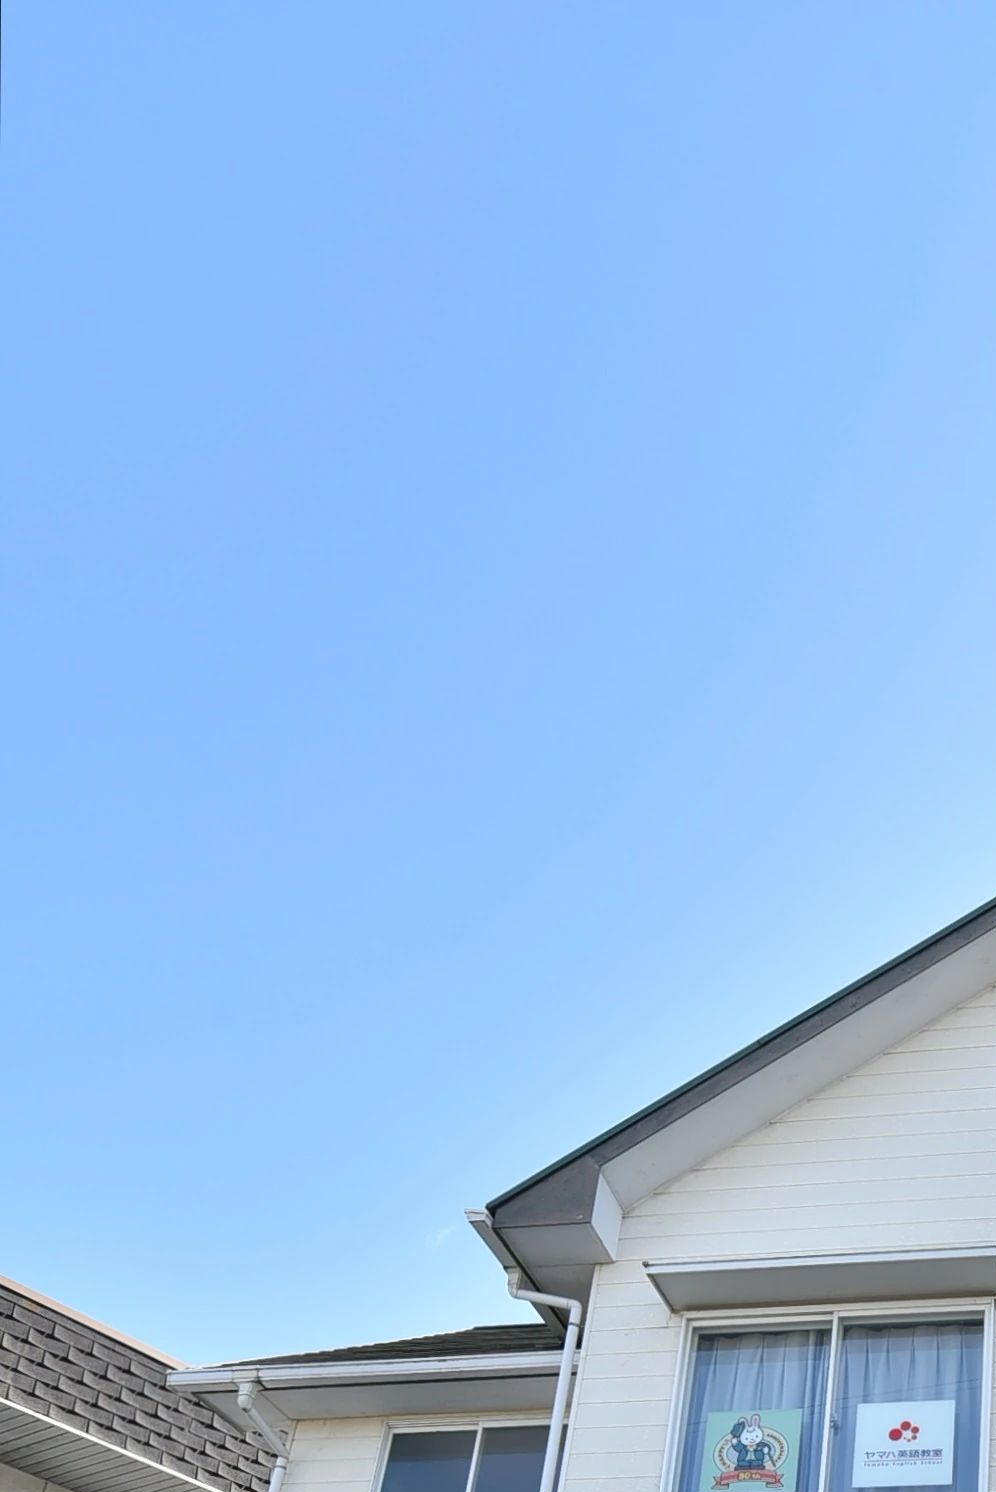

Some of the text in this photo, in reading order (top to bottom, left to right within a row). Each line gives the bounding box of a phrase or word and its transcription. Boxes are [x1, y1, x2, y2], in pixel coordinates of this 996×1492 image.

[864, 1448, 944, 1460] ヤマハ英語教室
